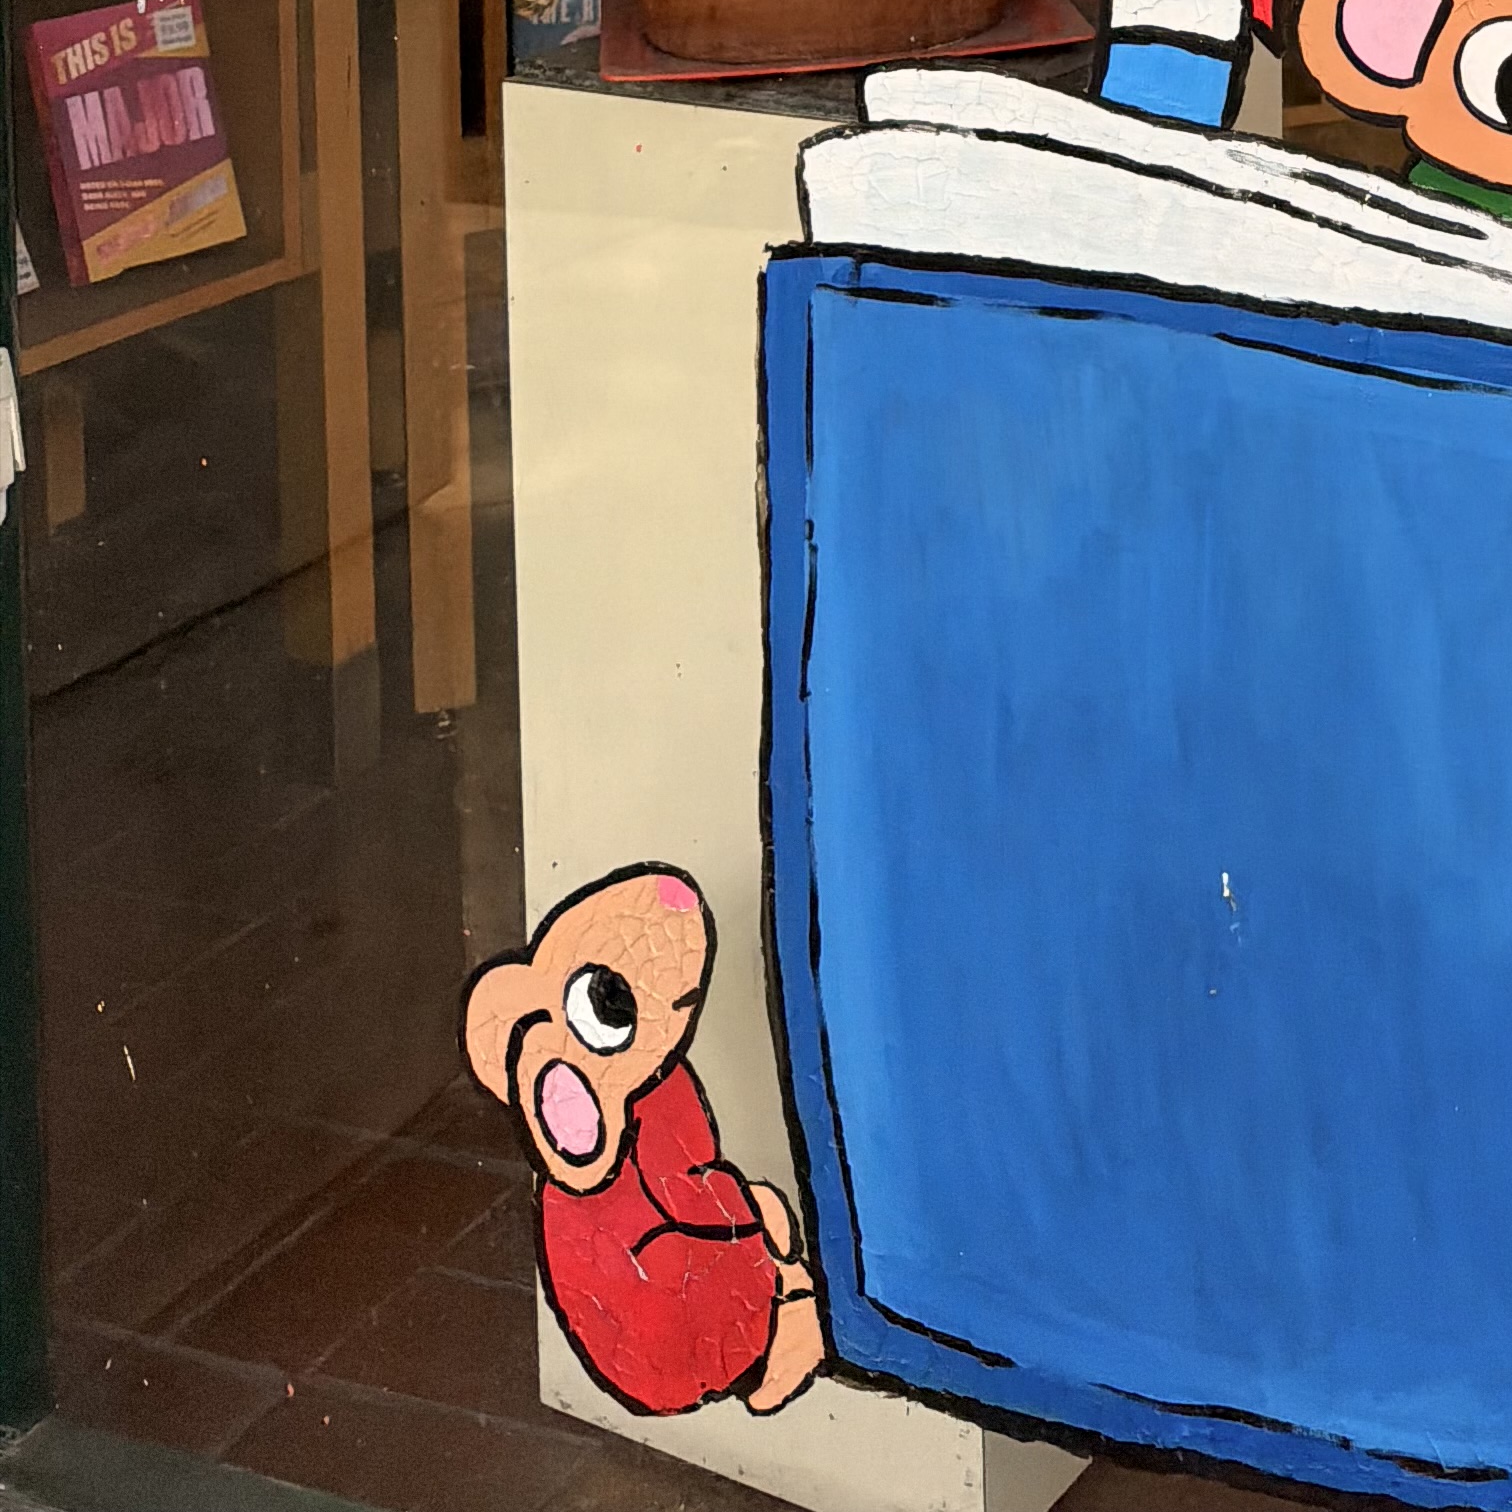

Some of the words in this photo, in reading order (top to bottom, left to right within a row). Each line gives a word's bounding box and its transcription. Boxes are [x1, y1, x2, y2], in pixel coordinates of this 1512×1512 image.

[51, 31, 110, 85] THIS
[110, 17, 138, 56] IS
[66, 66, 216, 170] MAJOR
